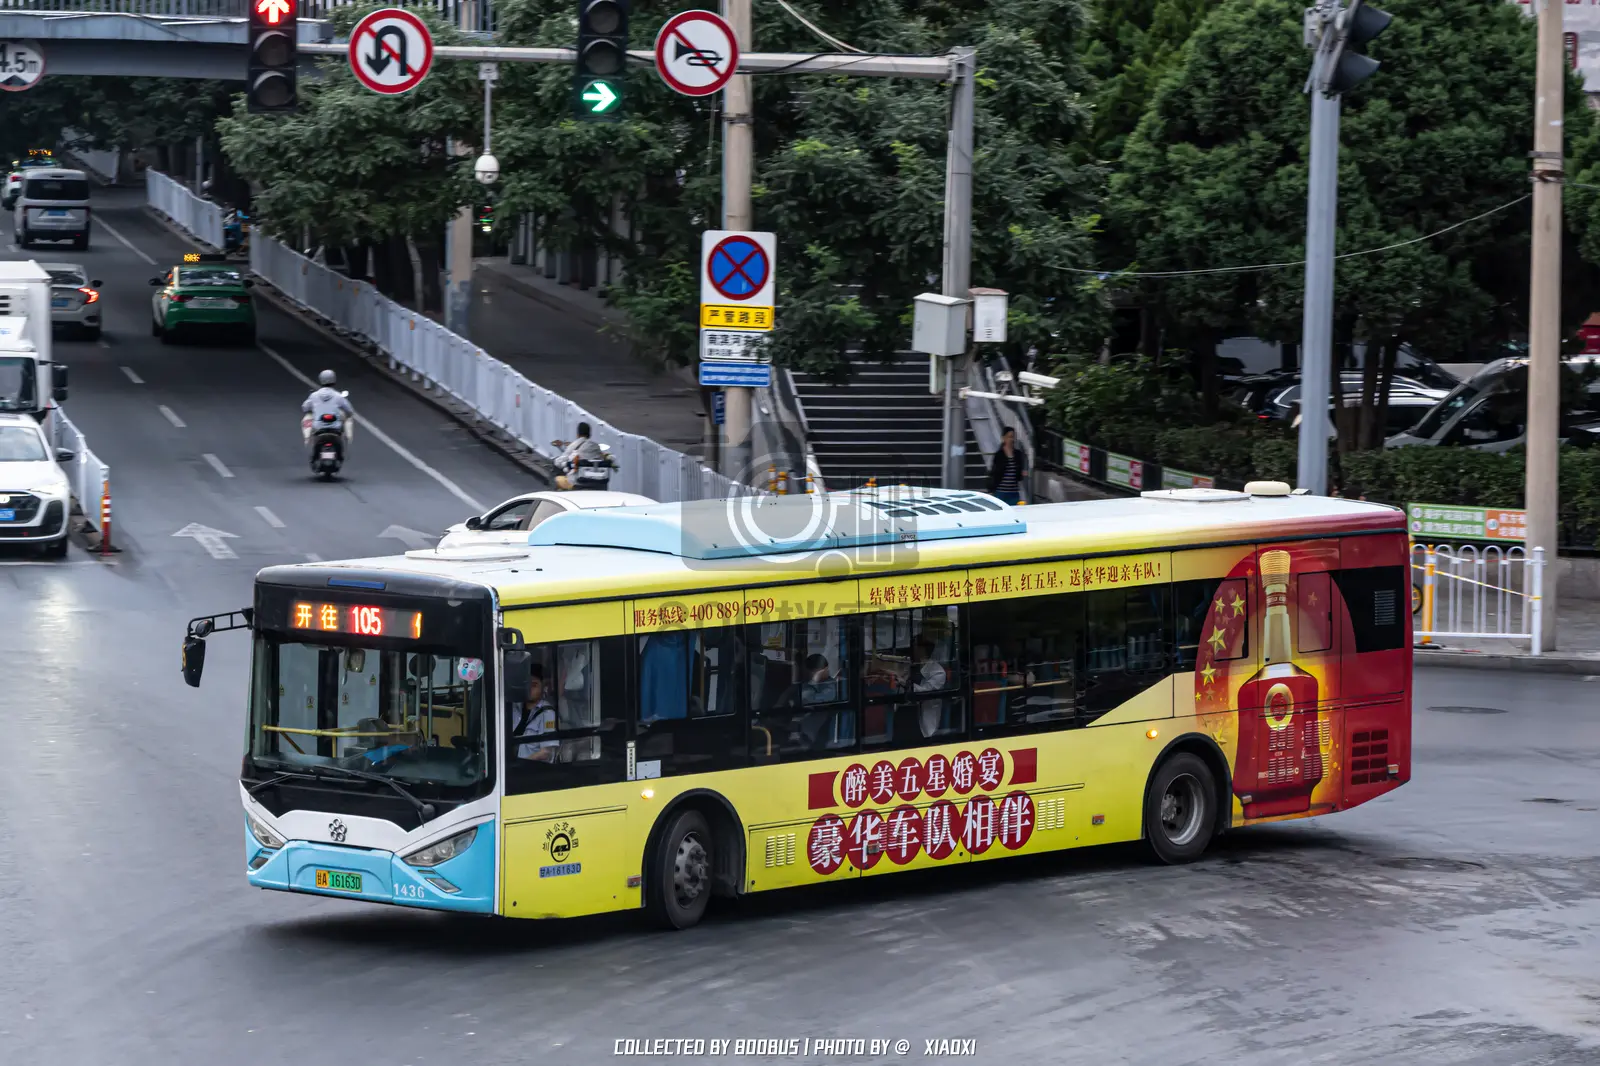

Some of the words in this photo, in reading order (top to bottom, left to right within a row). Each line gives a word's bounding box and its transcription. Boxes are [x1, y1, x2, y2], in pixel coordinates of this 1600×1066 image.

[297, 603, 338, 630] 开往
[351, 605, 382, 635] 105
[689, 603, 713, 621] 400
[716, 601, 740, 619] 889
[744, 597, 775, 617] 6599
[845, 751, 1001, 803] 醉美五星婚宴
[542, 821, 579, 851] 兰州公交集团
[810, 795, 1031, 869] 豪华车队相伴
[393, 883, 425, 899] 1436
